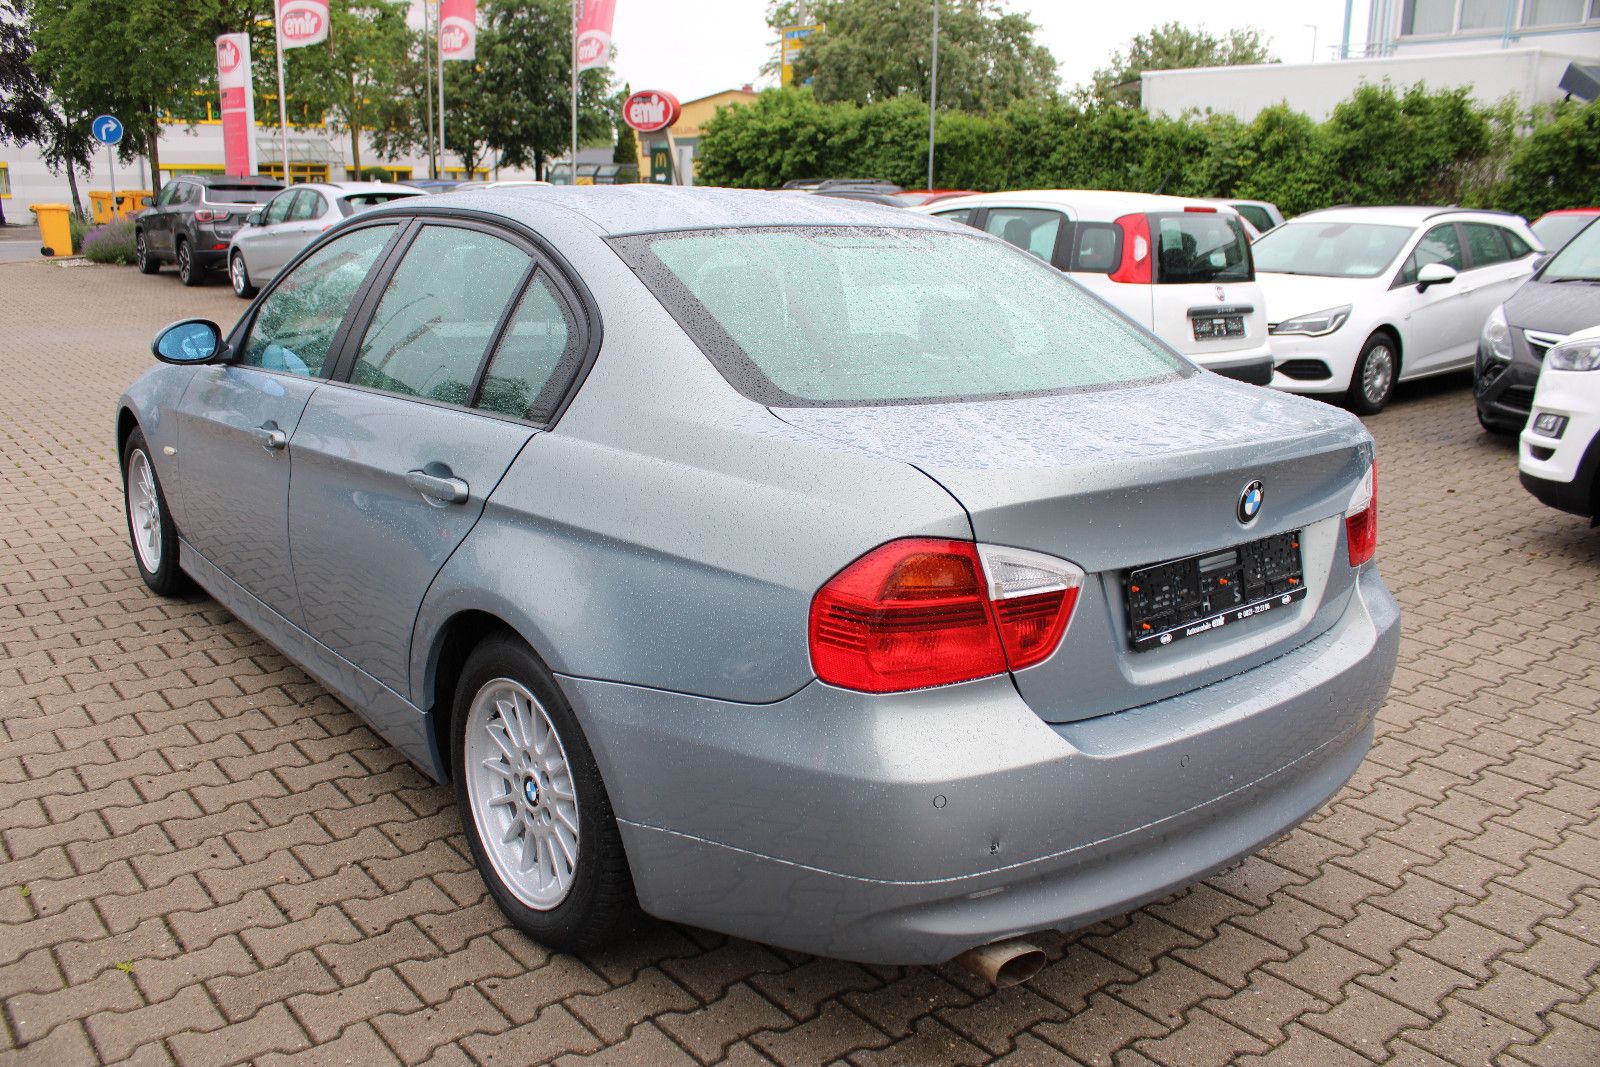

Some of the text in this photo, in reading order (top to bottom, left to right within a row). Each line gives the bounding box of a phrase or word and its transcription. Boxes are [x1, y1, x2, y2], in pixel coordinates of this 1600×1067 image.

[285, 12, 317, 35] emir
[630, 94, 665, 123] emir
[1211, 615, 1225, 627] emir
